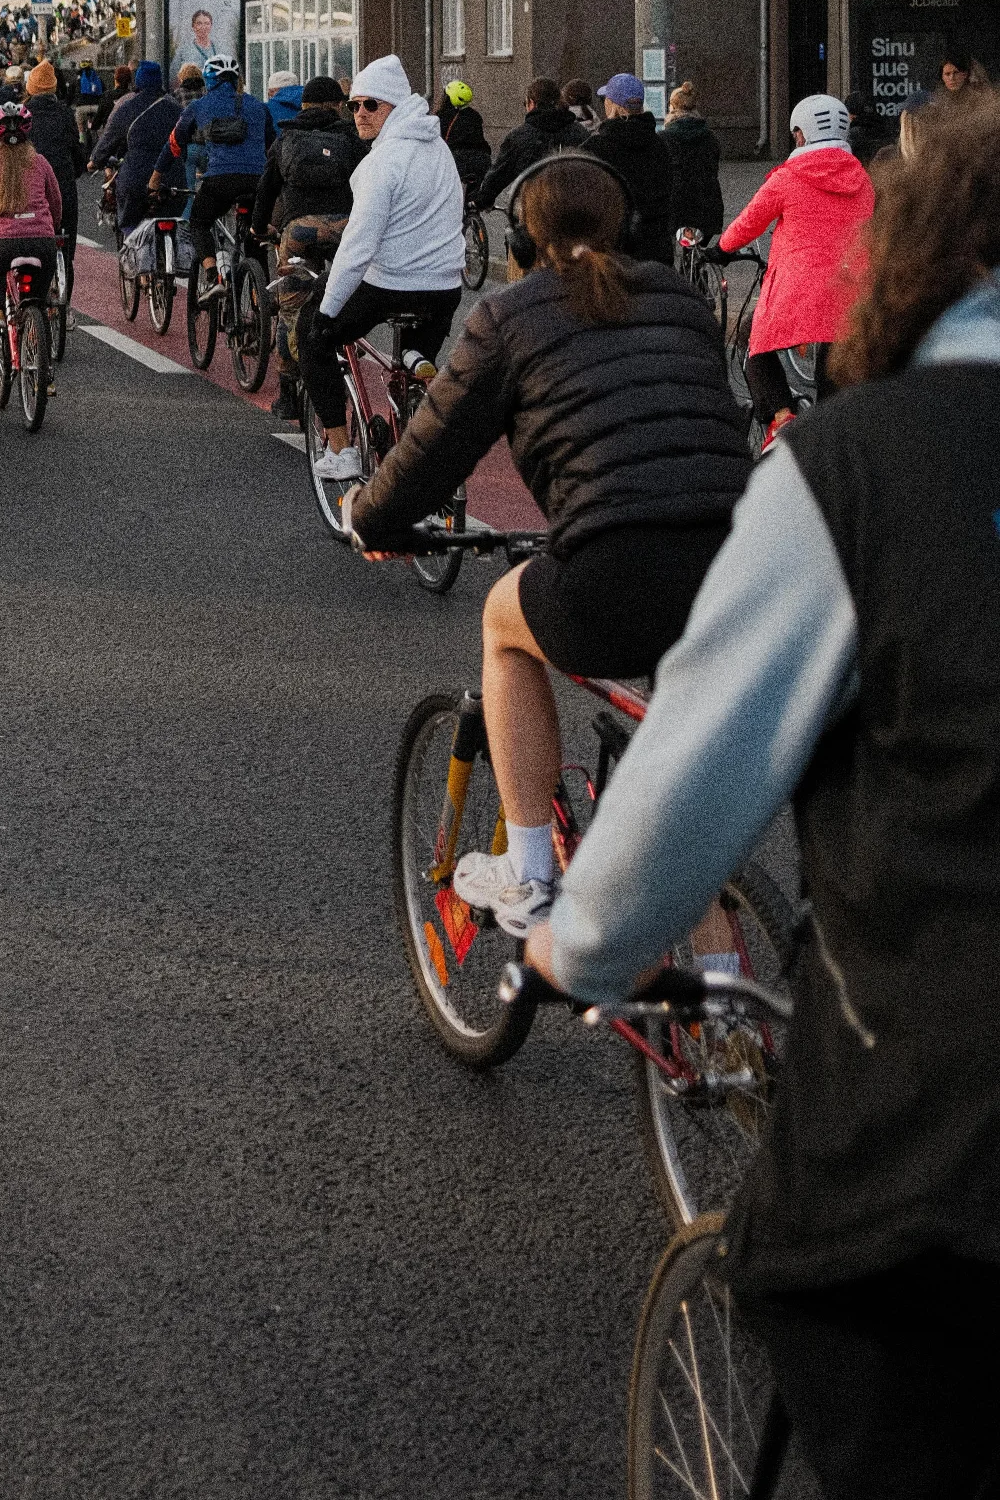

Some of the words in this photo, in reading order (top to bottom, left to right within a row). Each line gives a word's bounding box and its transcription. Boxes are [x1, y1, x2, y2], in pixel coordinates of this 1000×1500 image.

[871, 38, 915, 56] Sinu
[872, 63, 909, 76] uue
[872, 78, 921, 96] kodu
